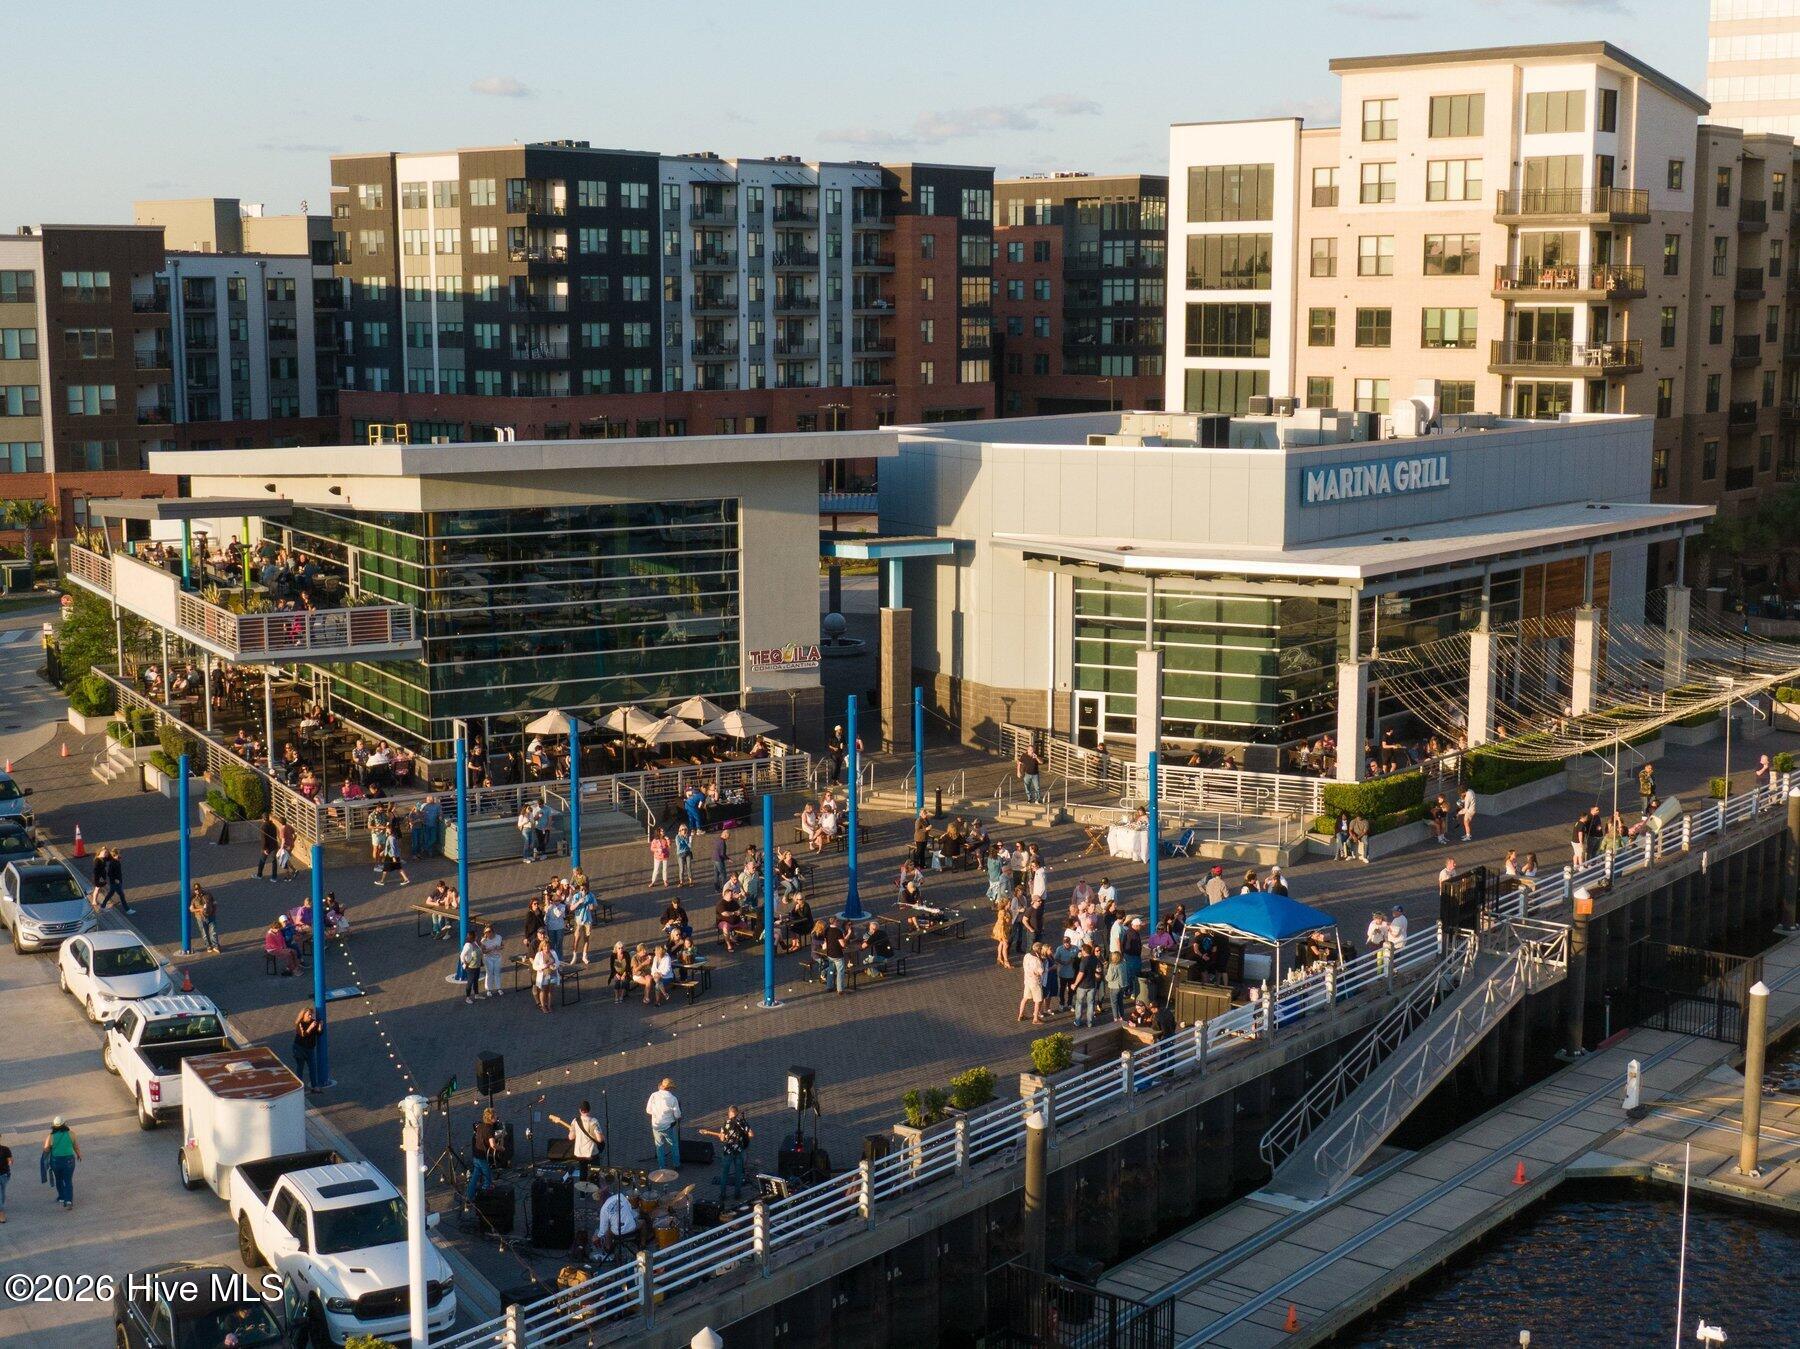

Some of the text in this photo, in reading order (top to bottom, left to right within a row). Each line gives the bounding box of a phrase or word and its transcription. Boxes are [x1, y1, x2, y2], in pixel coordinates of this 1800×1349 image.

[1307, 457, 1449, 502] MARINA GRILL
[749, 645, 821, 665] TEQUILA
